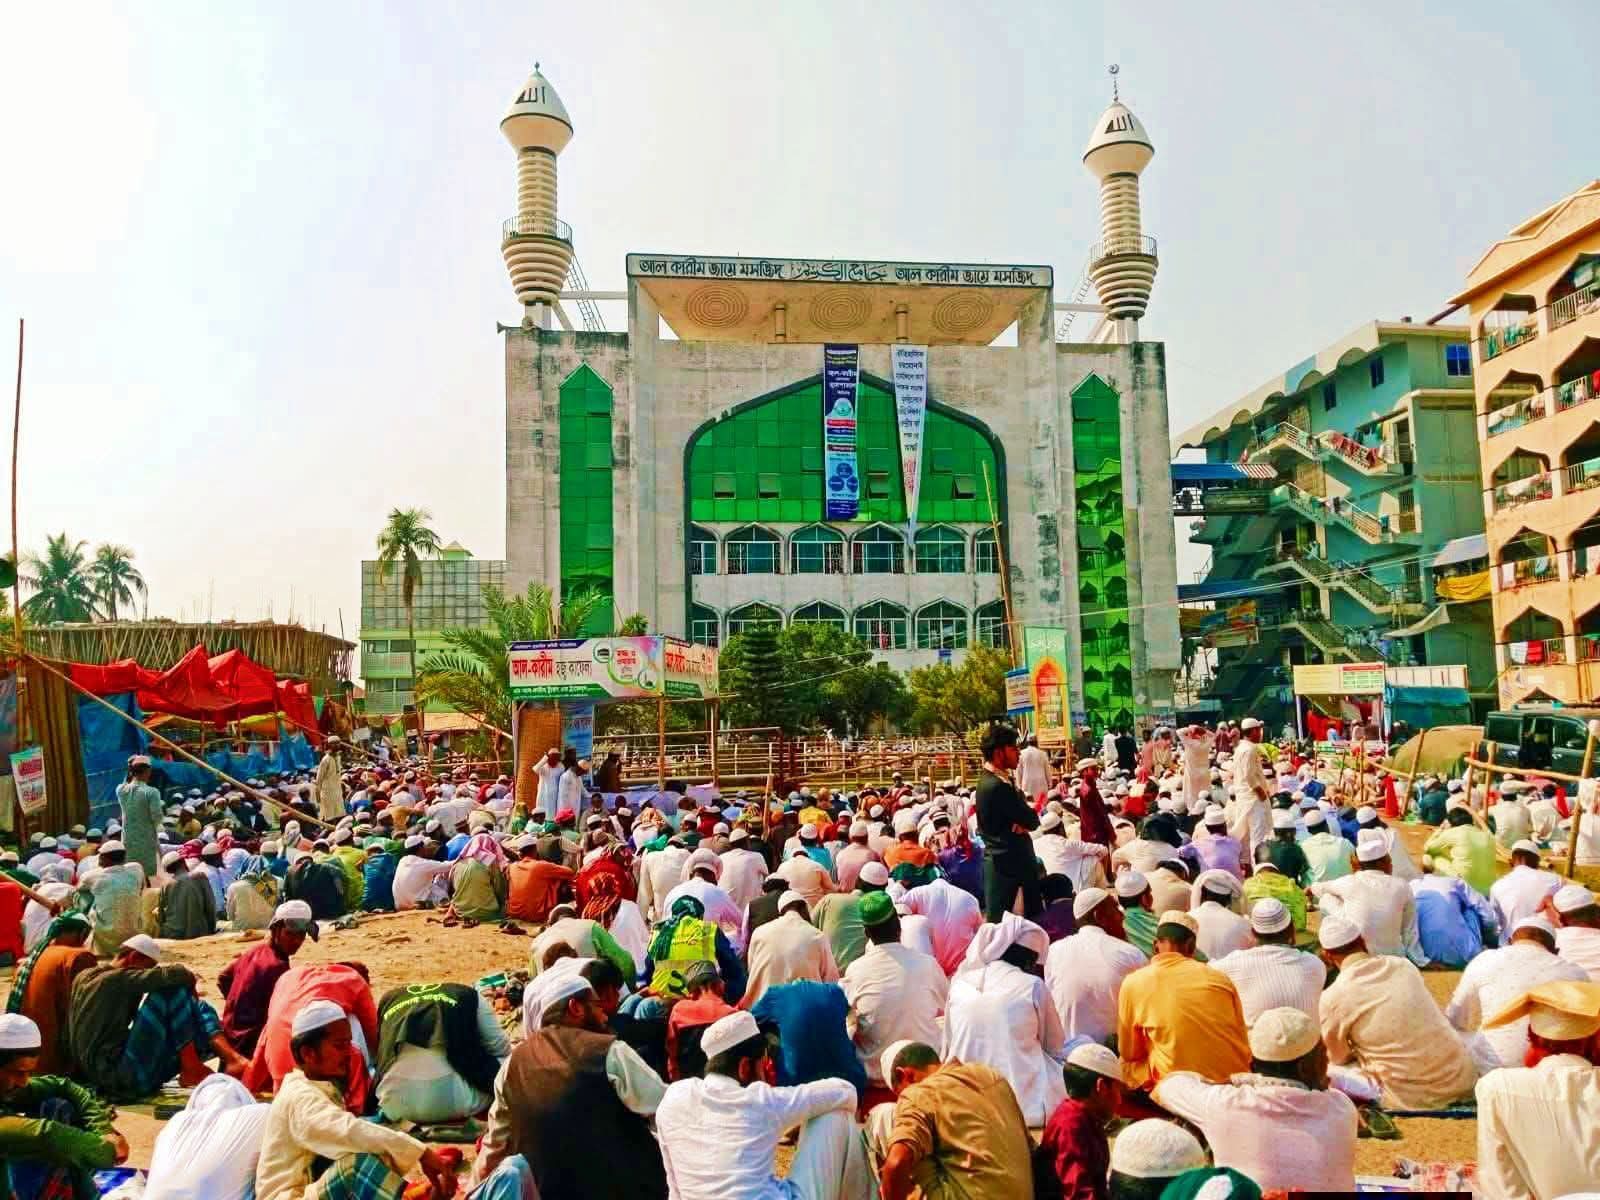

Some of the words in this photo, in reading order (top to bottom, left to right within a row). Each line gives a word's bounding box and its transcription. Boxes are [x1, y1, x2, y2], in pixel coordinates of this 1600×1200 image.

[639, 259, 667, 275] আল
[671, 257, 706, 276] কারীম
[708, 261, 737, 278] জামে
[740, 260, 785, 279] মসজিদ
[895, 267, 922, 282] আল
[925, 264, 959, 283] কারীম
[962, 269, 989, 285] জামে
[994, 267, 1038, 286] মসজিদ
